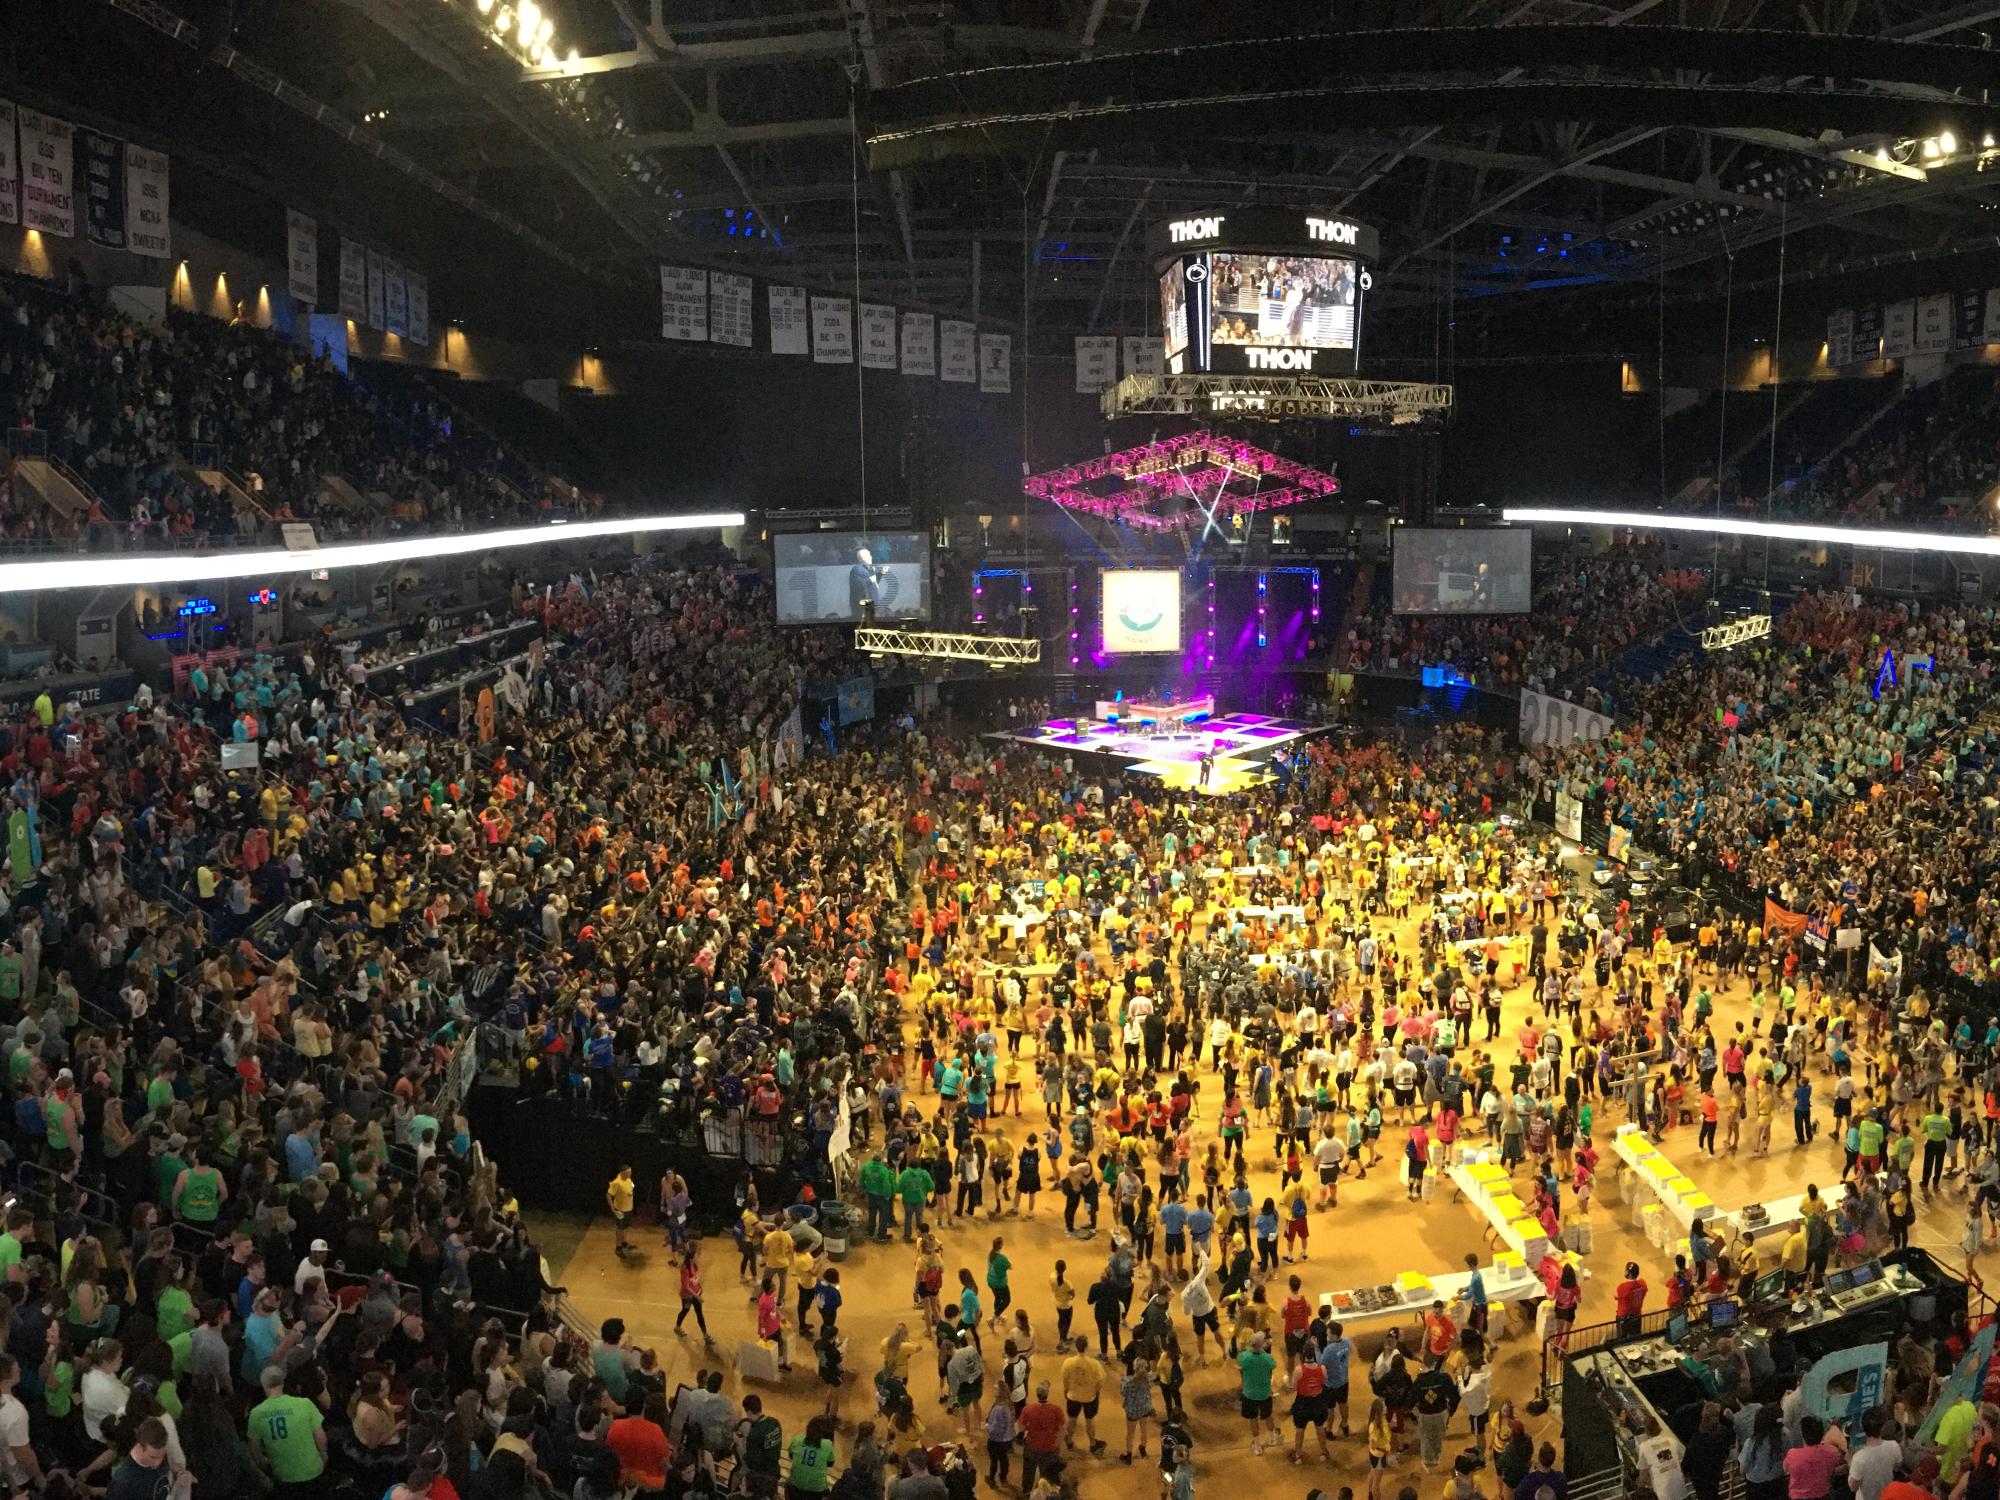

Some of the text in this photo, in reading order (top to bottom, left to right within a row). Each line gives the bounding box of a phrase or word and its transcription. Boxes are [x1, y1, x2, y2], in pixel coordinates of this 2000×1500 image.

[1170, 219, 1220, 242] THON
[1306, 218, 1356, 244] THON
[1245, 348, 1312, 370] THON
[268, 1416, 289, 1441] 18
[801, 1447, 817, 1467] 18
